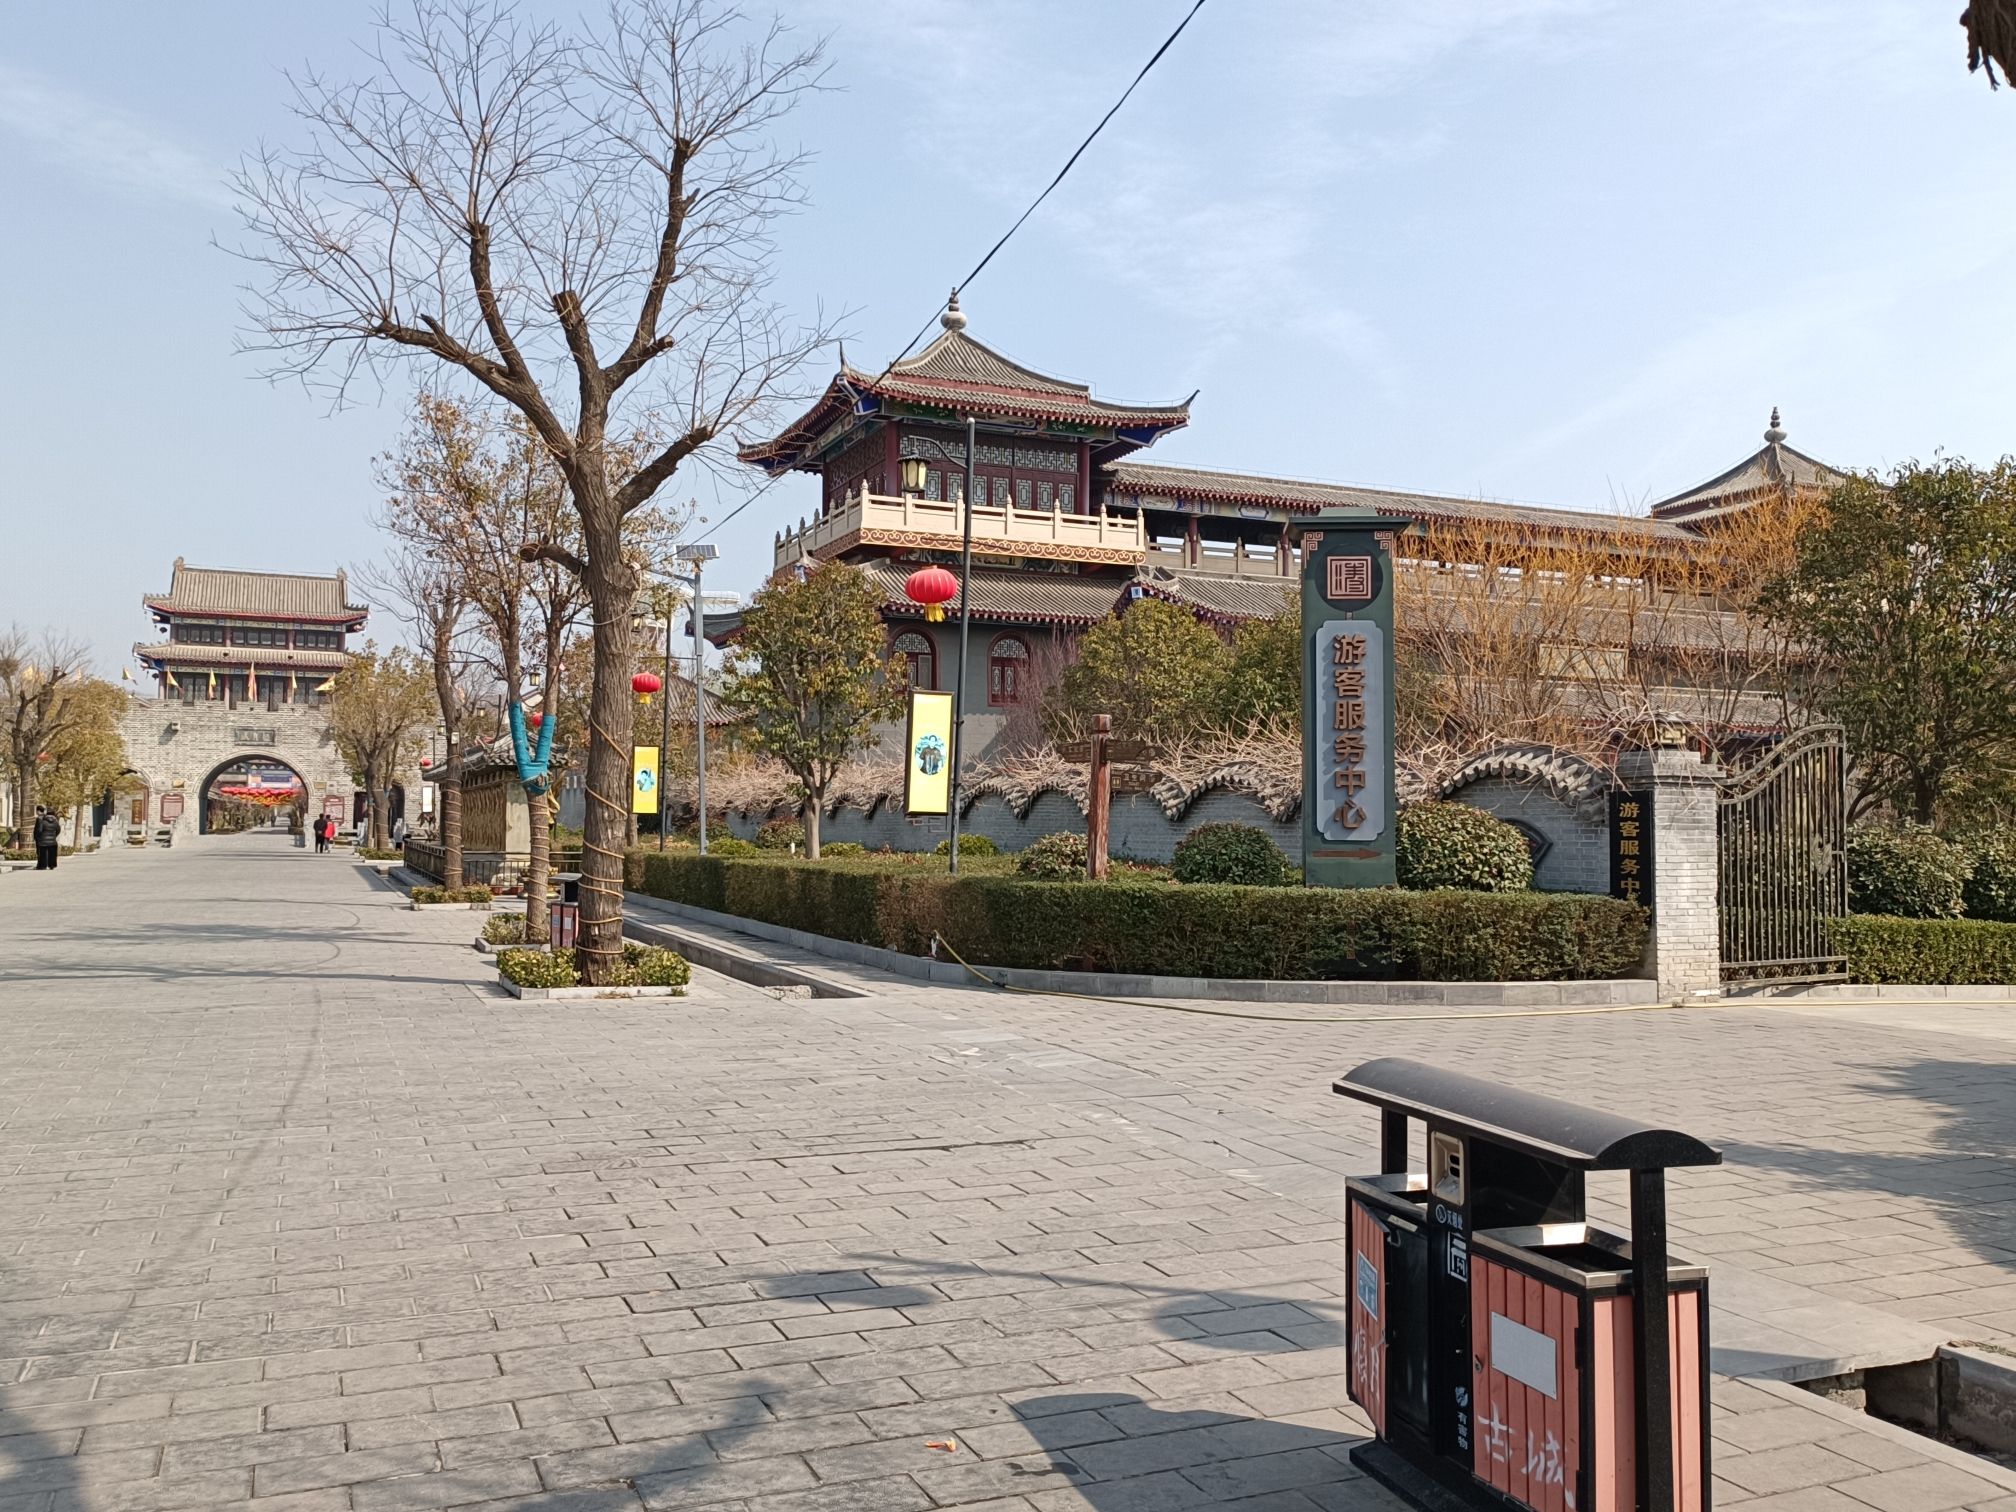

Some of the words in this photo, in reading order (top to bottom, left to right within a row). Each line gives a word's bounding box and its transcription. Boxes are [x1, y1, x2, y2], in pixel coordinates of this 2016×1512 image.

[1334, 634, 1367, 830] 游客服务中心
[1619, 802, 1640, 898] 游客服务中
